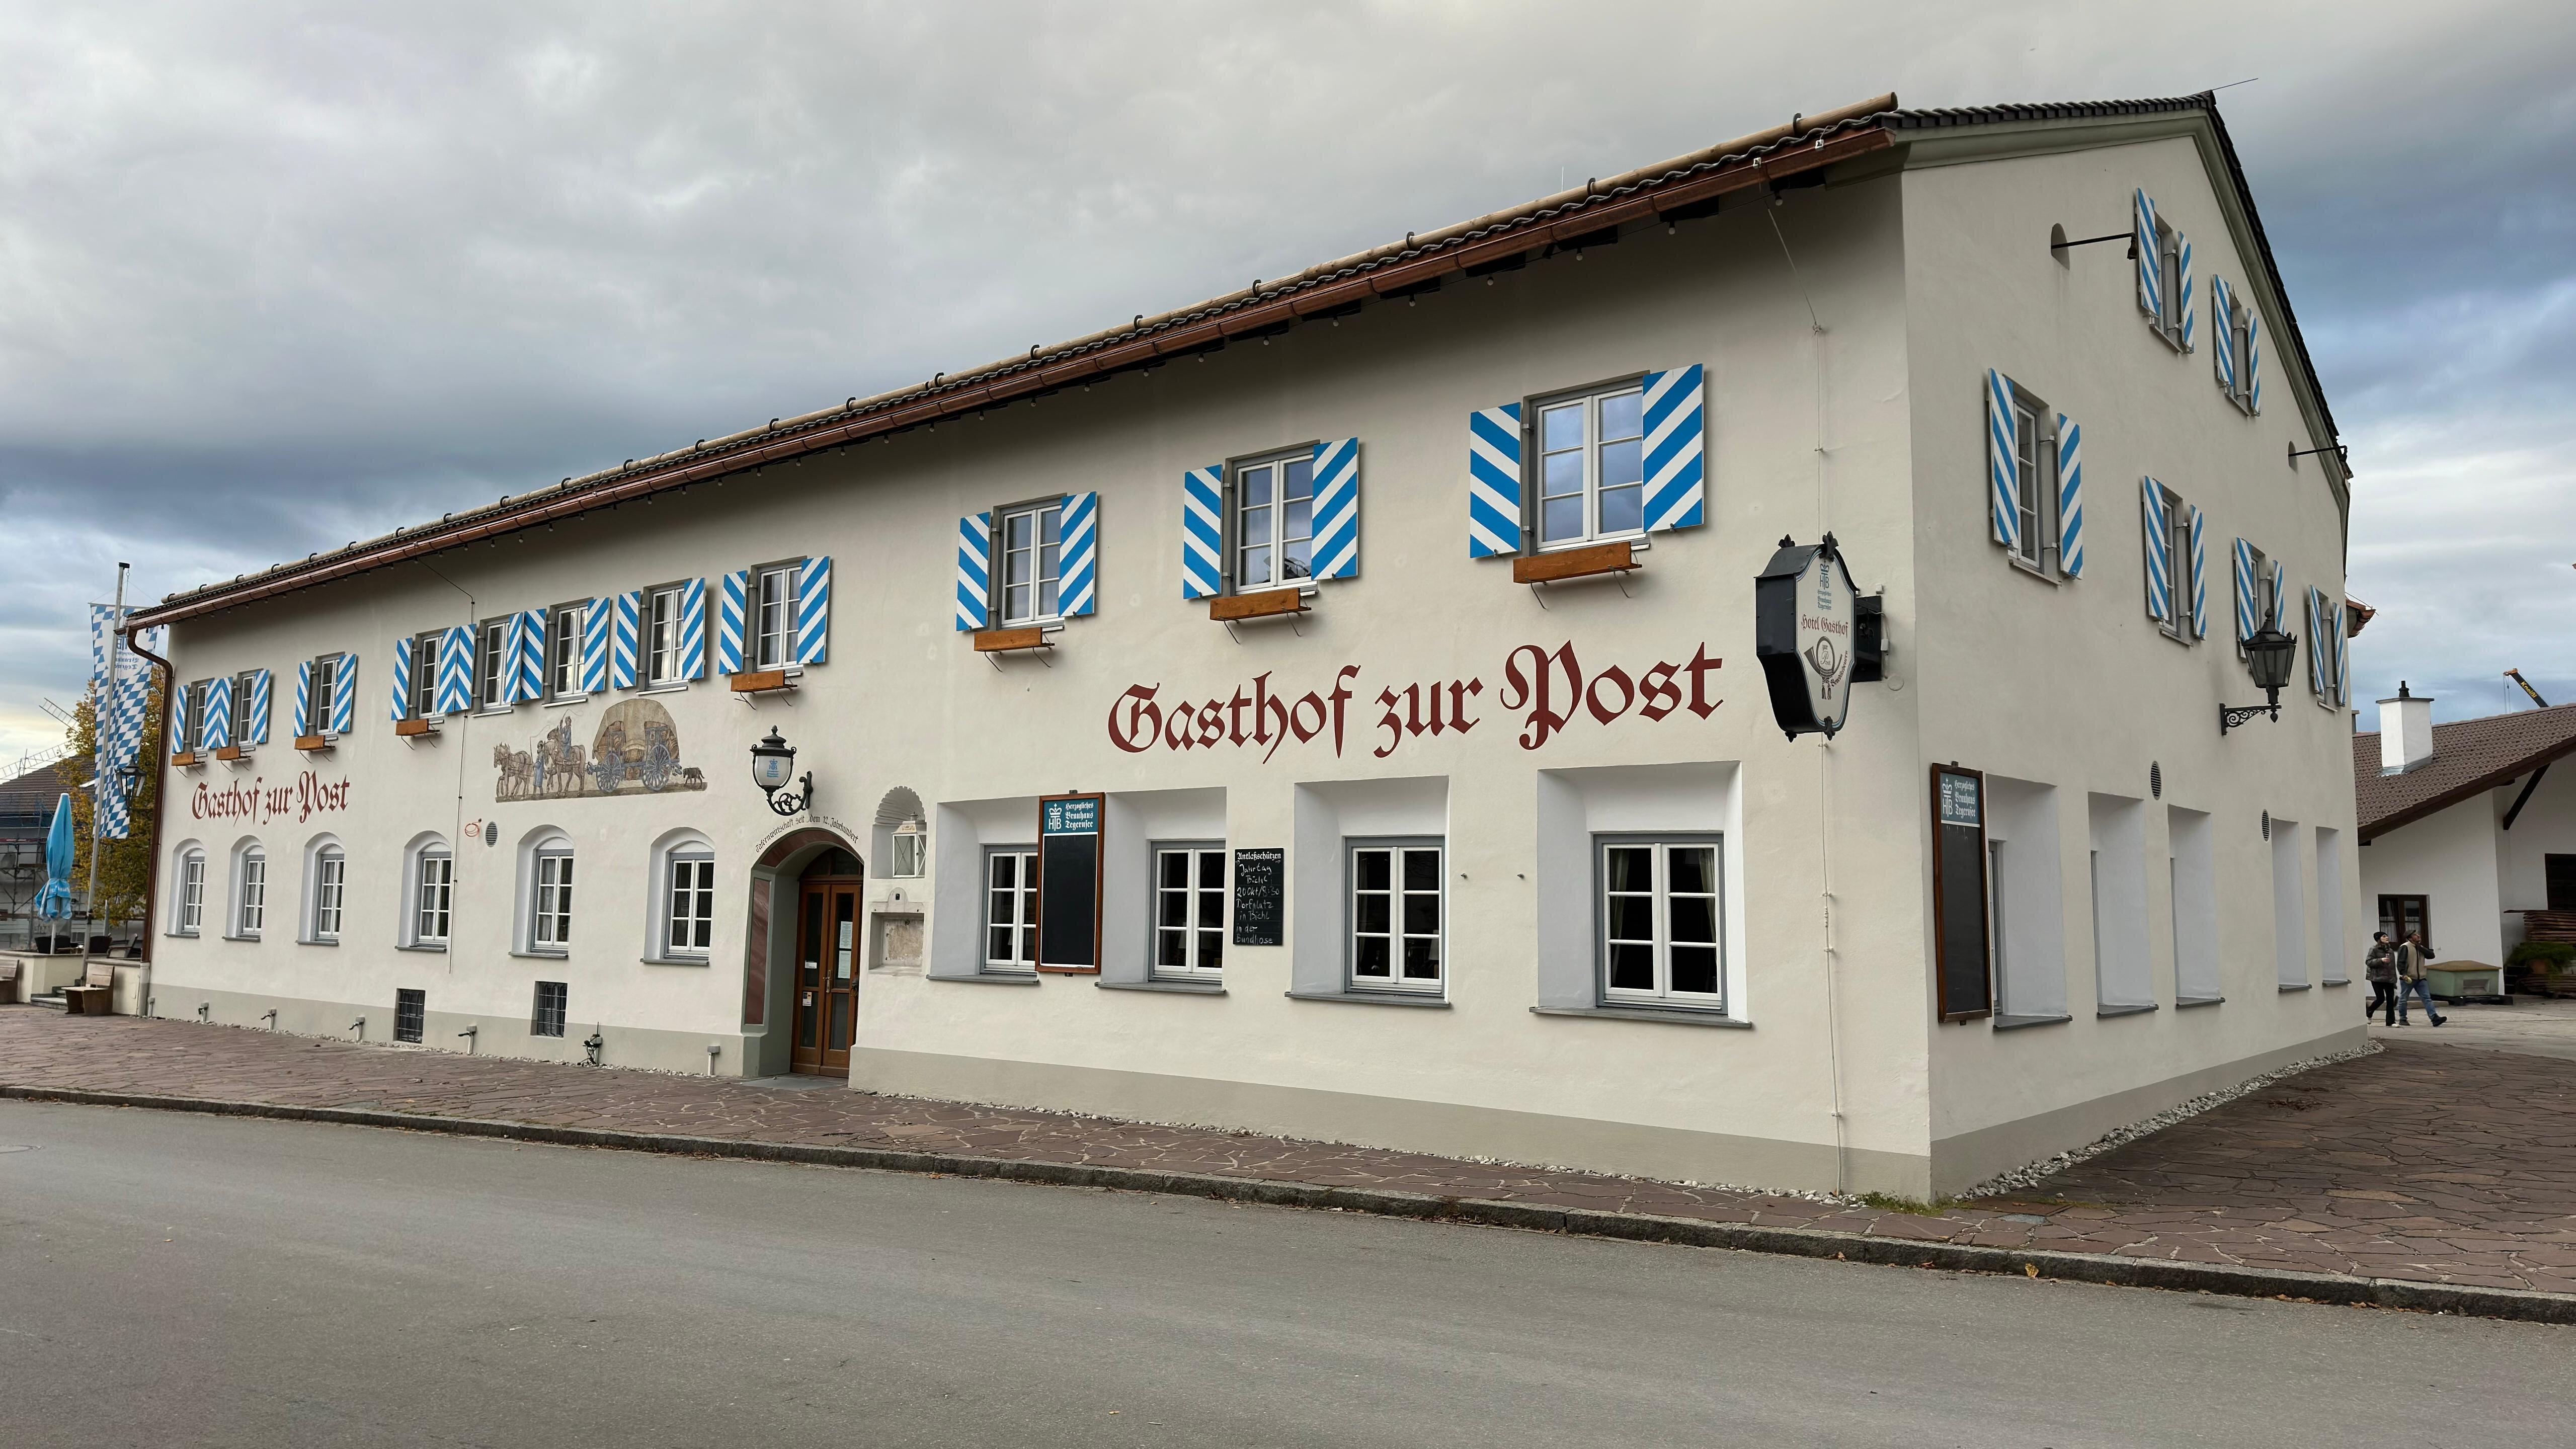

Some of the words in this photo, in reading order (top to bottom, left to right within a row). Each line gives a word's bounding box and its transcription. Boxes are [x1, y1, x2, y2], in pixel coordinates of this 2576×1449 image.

[1801, 614, 1820, 631] Hotel
[1821, 617, 1848, 638] Gasthof
[1107, 664, 1361, 764] Gasthof
[1373, 676, 1484, 758] zur
[1500, 639, 1724, 751] Post
[192, 776, 263, 827] Gasthof
[263, 786, 293, 825] zur
[296, 769, 350, 824] Post
[1955, 791, 1975, 806] Brauhaus
[1065, 801, 1094, 811] Herzogliches
[1065, 811, 1093, 821] Brauhaus
[1065, 820, 1093, 830] Tegernsee
[756, 818, 793, 853] Tafernwirtschaft
[795, 815, 805, 824] seit
[810, 814, 820, 823] dem
[830, 818, 858, 844] Jahrhundert
[1237, 851, 1281, 861] Antlaßschützen
[1239, 863, 1272, 876] Jahrtag
[1236, 899, 1274, 911] Dorfplatz
[1240, 911, 1246, 920] in
[1236, 923, 1242, 932] in
[1245, 923, 1258, 932] der
